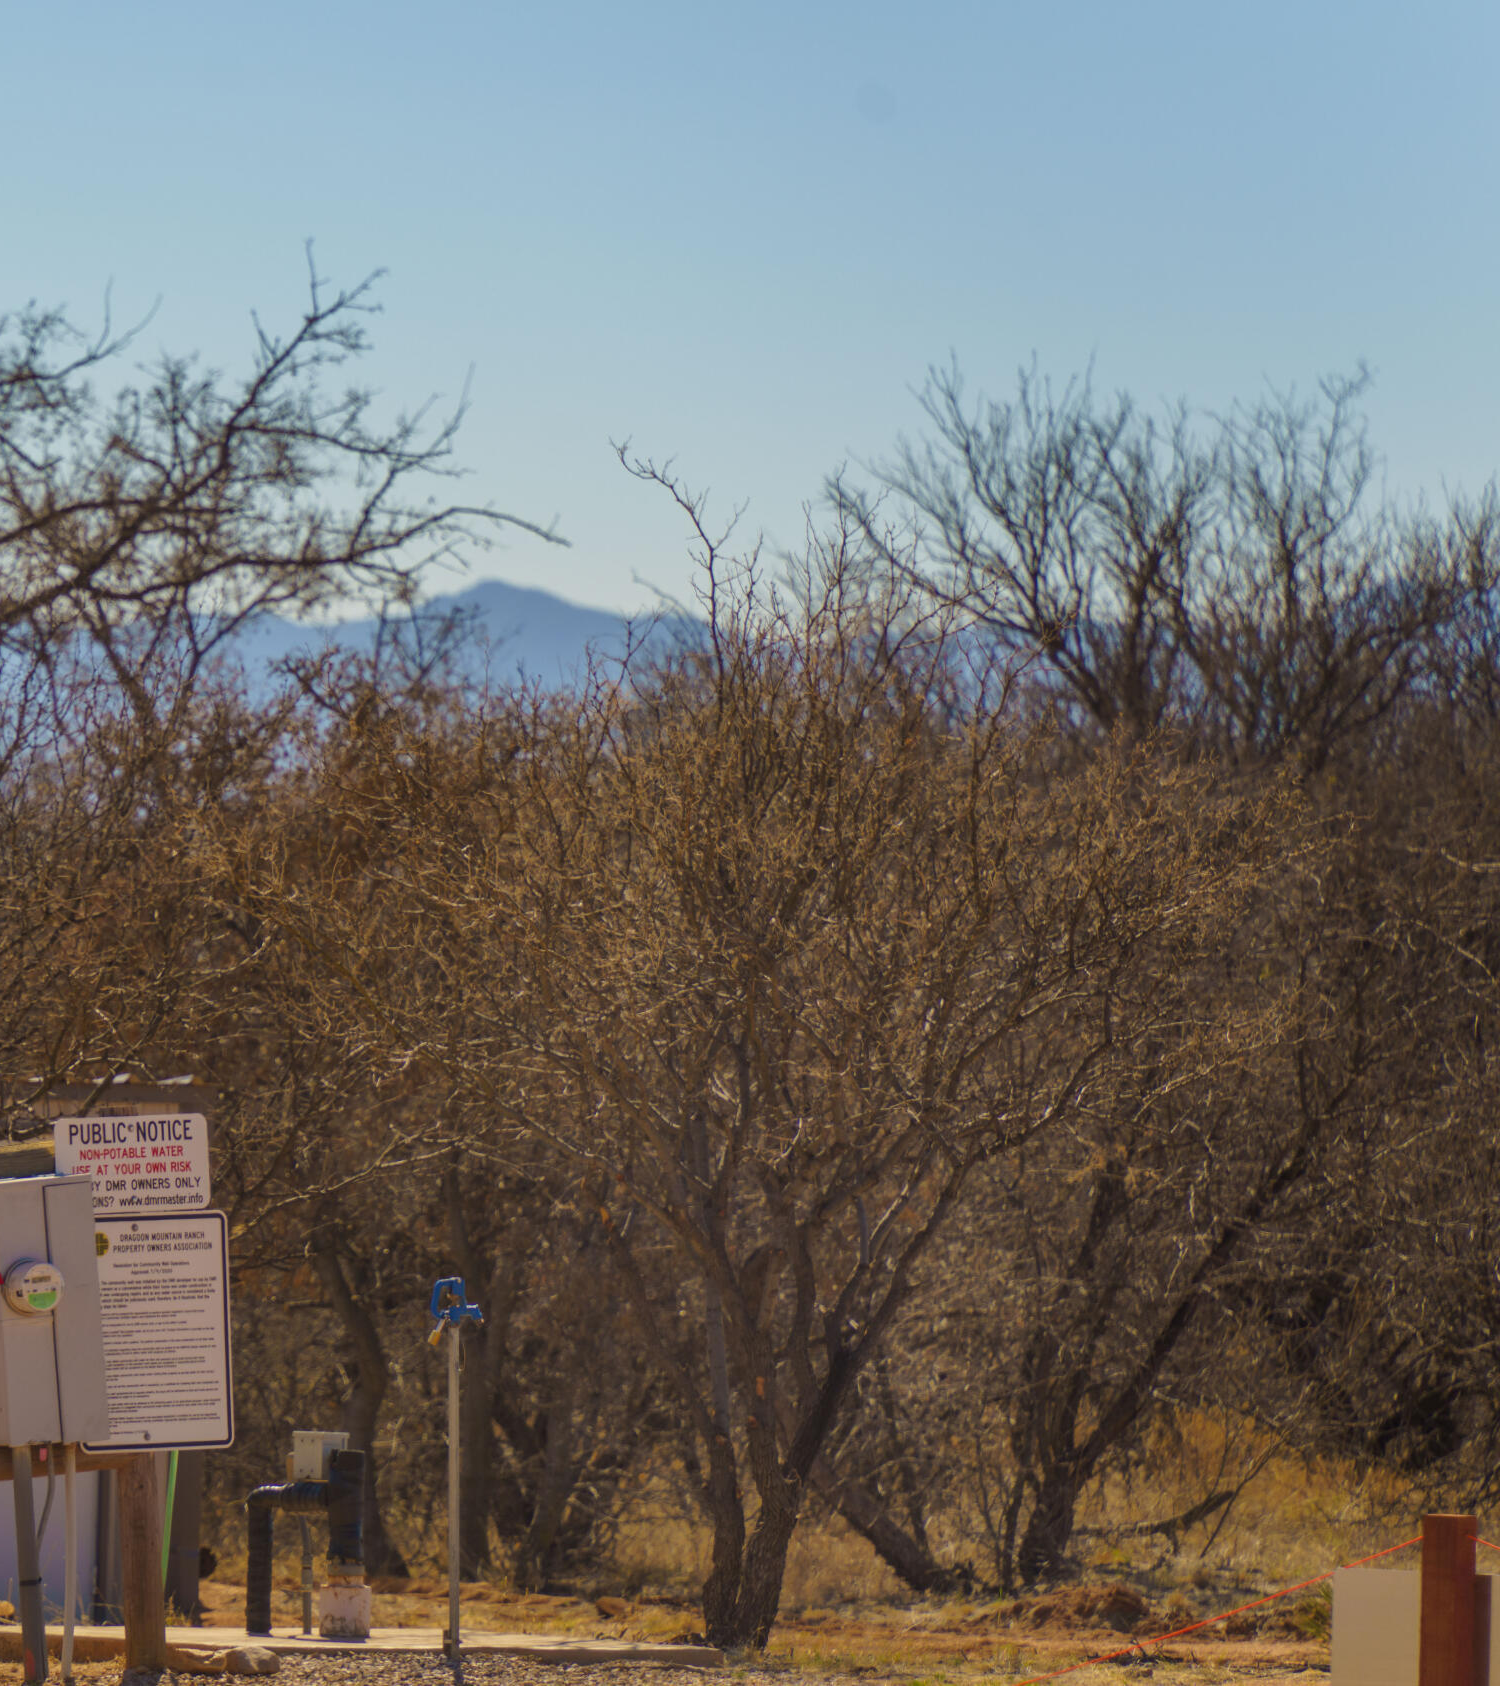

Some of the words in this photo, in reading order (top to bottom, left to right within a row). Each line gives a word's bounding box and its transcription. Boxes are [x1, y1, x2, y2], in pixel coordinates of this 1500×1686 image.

[69, 1122, 127, 1146] PUBLIC
[136, 1119, 193, 1142] NOTICE
[79, 1147, 147, 1160] NON-POTABLE
[151, 1145, 184, 1157] WATER
[96, 1164, 108, 1176] AT
[114, 1162, 141, 1175] YOUR
[145, 1162, 167, 1174] OWN
[170, 1160, 192, 1172] RISK
[105, 1179, 127, 1191] DMR
[131, 1178, 171, 1190] OWNERS
[175, 1176, 202, 1188] ONLY
[151, 1232, 183, 1241] MOUNTAIN
[184, 1231, 205, 1240] RANCH
[113, 1245, 145, 1253] PROPERTY
[147, 1243, 172, 1252] OWNERS
[173, 1241, 213, 1251] ASSOCIATION
